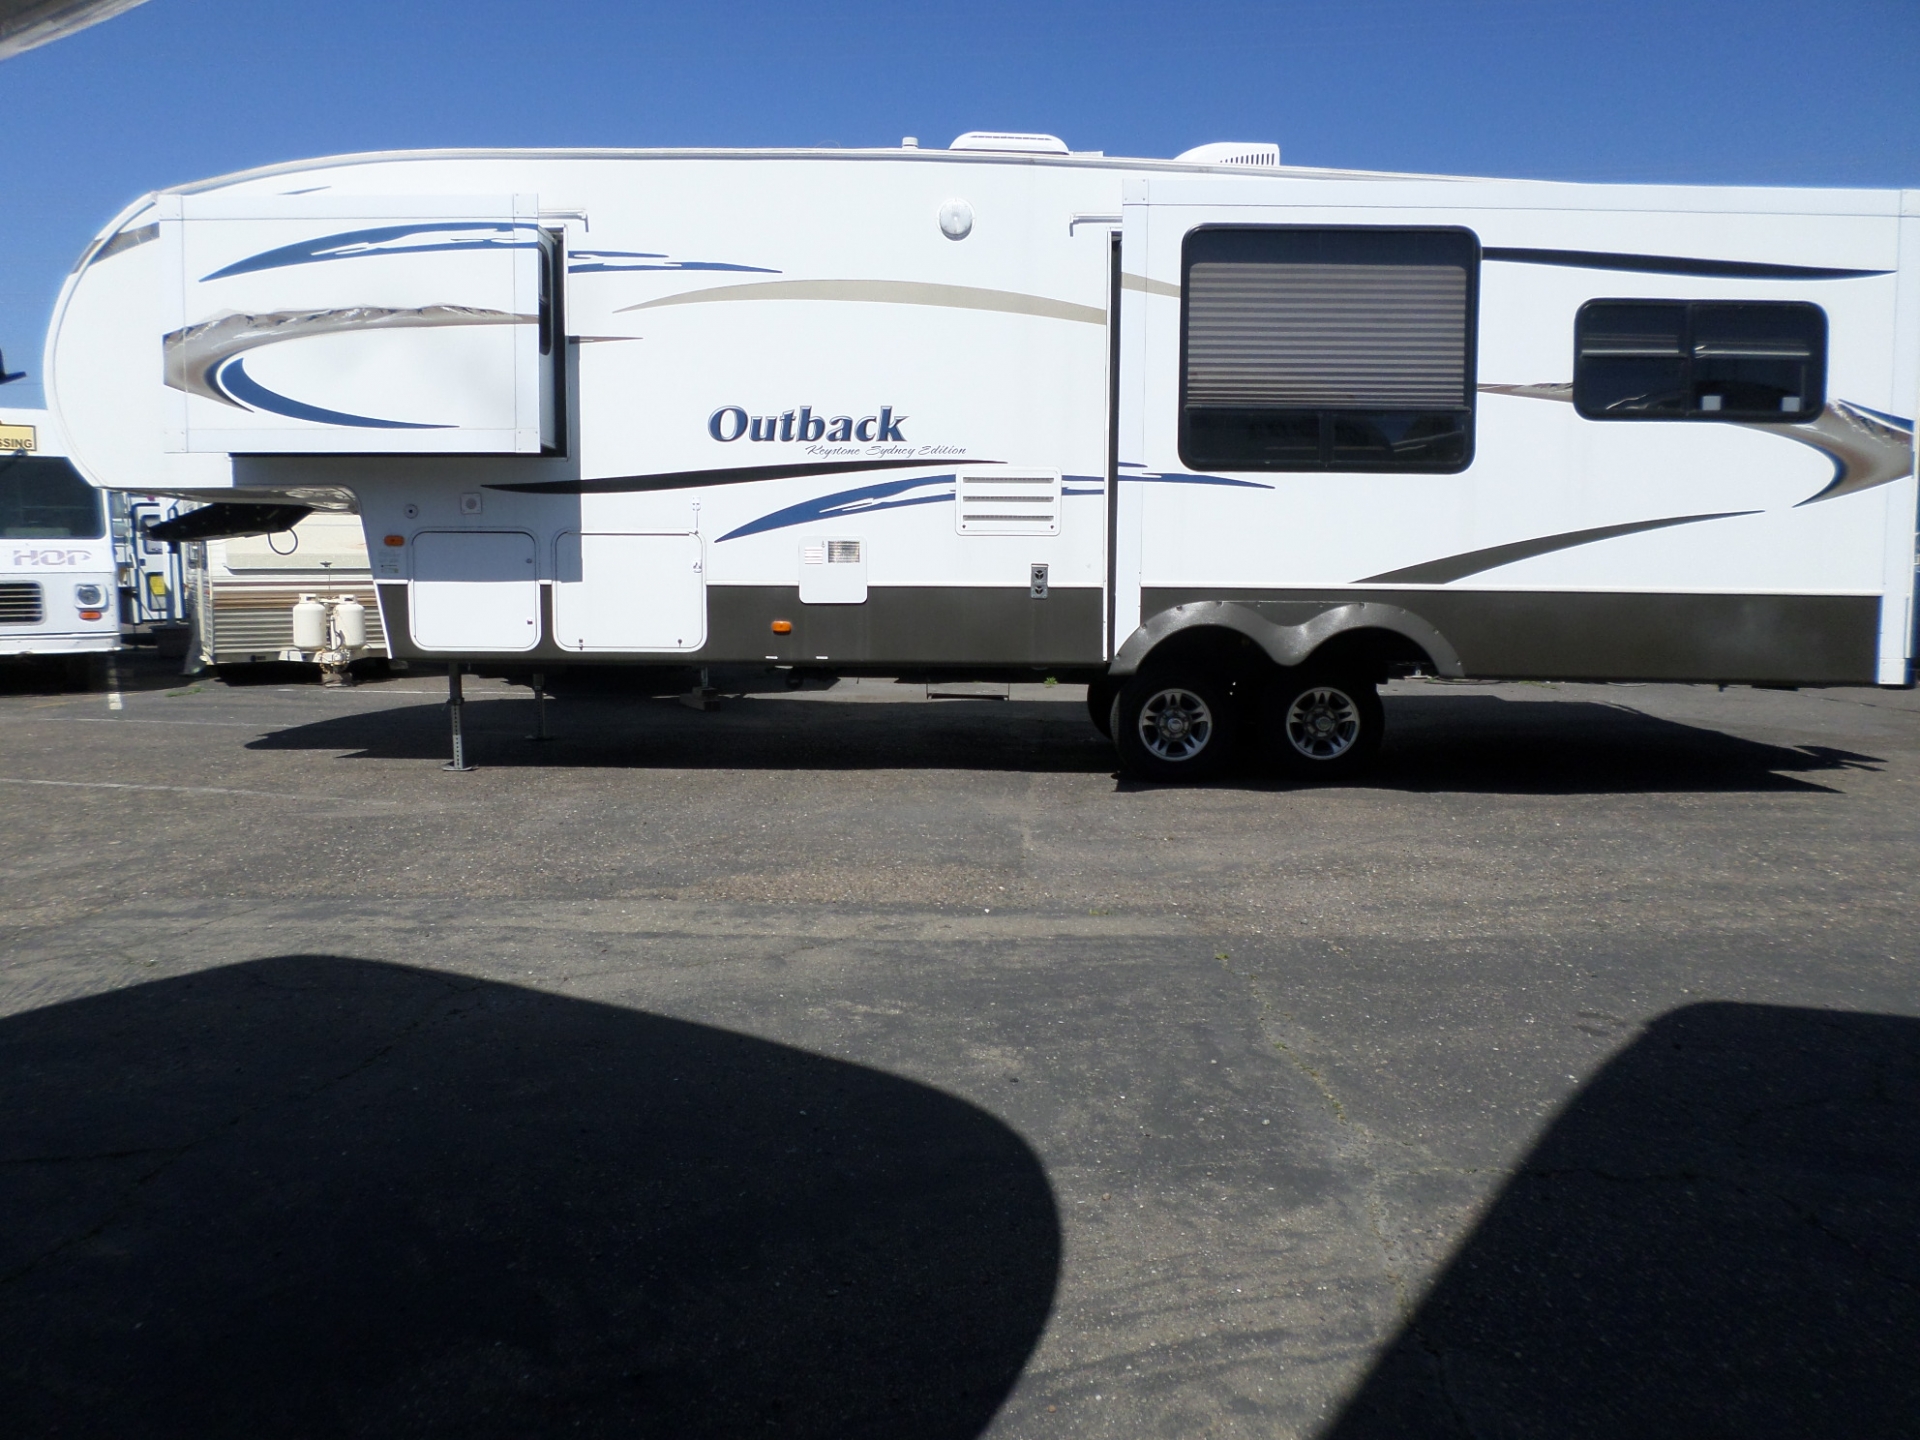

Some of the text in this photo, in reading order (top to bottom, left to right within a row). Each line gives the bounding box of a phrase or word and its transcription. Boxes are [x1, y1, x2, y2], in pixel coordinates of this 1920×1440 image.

[708, 405, 909, 442] Outback
[805, 444, 967, 459] Keystone Sydney Edition
[13, 550, 92, 566] HOP
